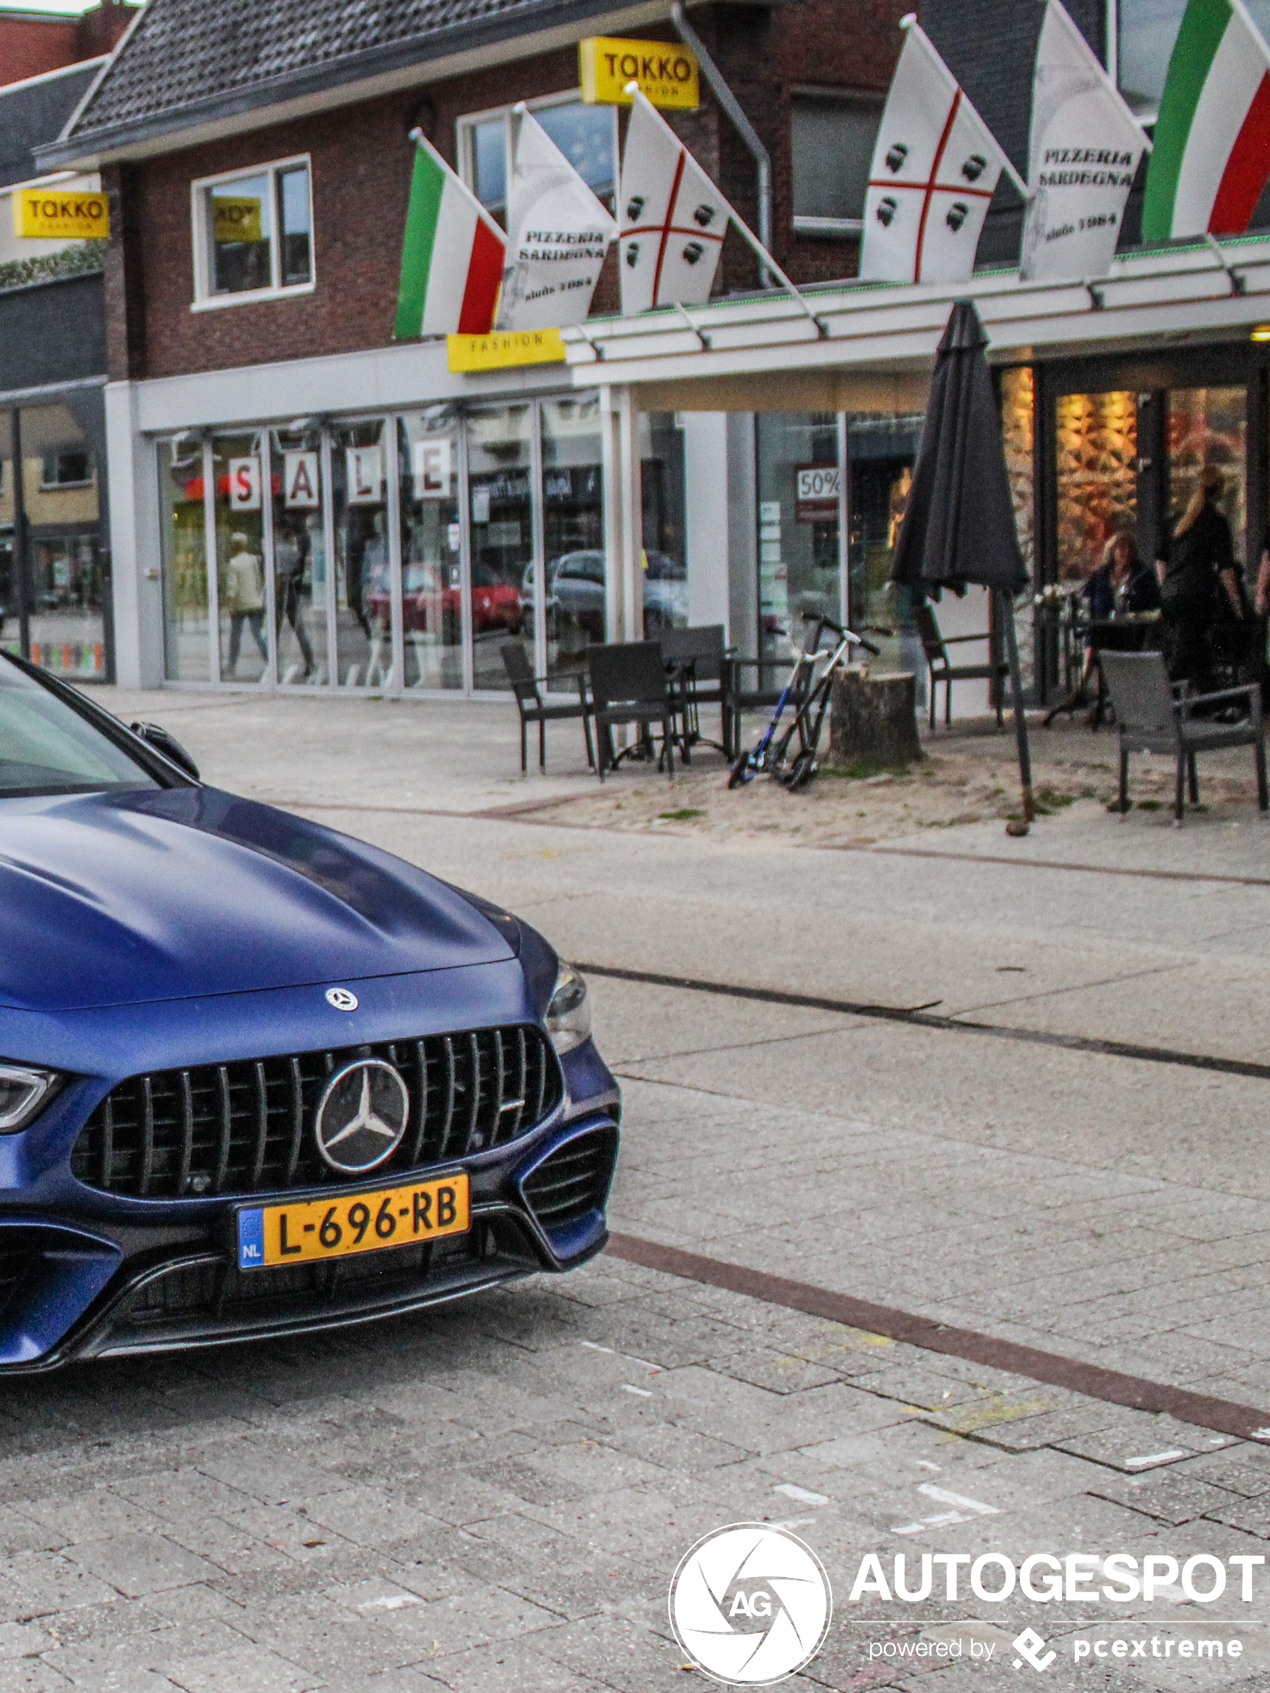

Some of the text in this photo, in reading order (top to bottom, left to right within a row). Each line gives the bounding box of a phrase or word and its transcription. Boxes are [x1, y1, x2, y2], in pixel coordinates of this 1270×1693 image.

[1045, 147, 1132, 166] PIZZERIA
[1038, 170, 1134, 187] SARDEGNA
[526, 231, 605, 243] PIZZERIA
[518, 248, 606, 261] SARDEGNA
[470, 332, 543, 353] FASHION
[801, 471, 840, 496] 50%
[279, 1186, 457, 1256] L-696-RB
[242, 1244, 261, 1259] NL
